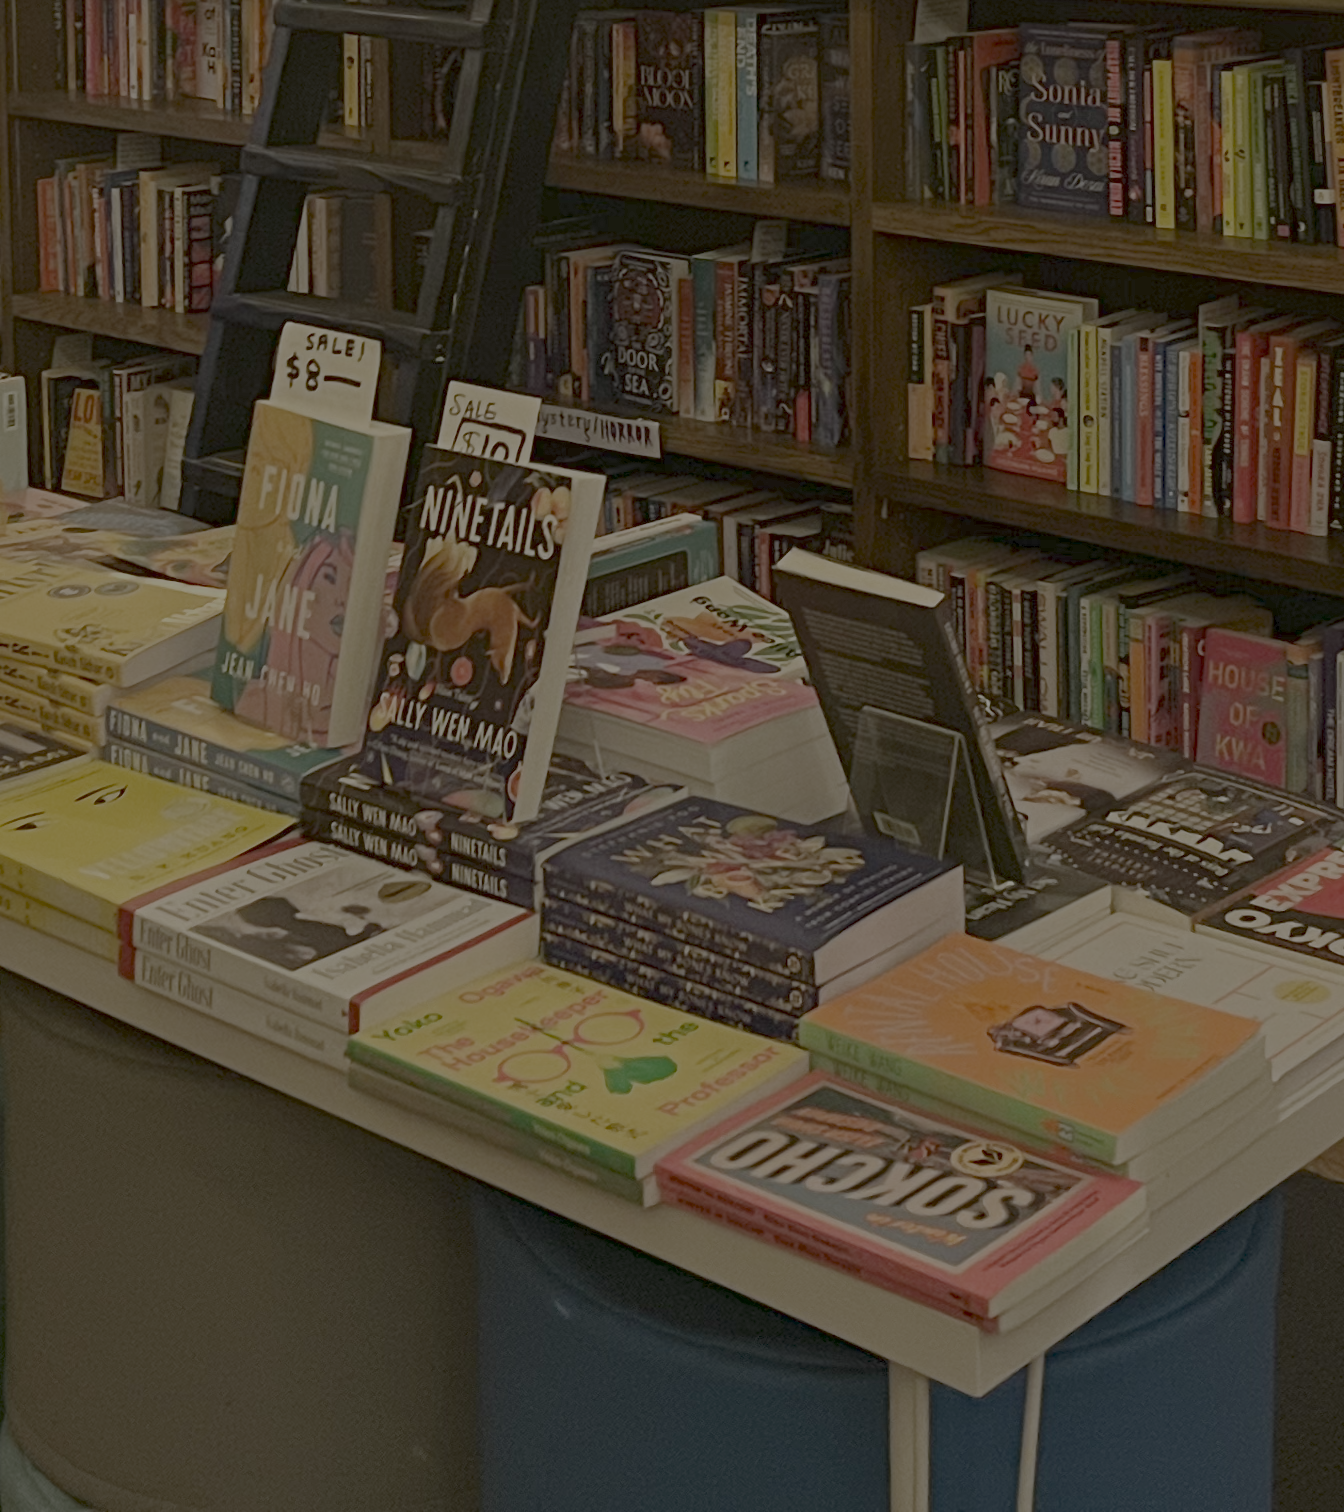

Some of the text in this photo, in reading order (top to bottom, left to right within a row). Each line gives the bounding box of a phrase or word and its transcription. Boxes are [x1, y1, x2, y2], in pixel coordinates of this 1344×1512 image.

[1030, 76, 1102, 108] Sonia
[1027, 112, 1105, 151] Sunny
[996, 306, 1068, 333] LUCKY
[1005, 327, 1056, 351] SEED
[306, 333, 367, 362] SALE!
[618, 348, 660, 373] DOOR
[449, 394, 497, 420] SALE
[624, 374, 650, 394] SEA
[1139, 354, 1151, 418] BLESSINGS
[461, 431, 510, 464] $10
[259, 464, 338, 533] FIONA
[421, 484, 558, 560] NINETAILS
[245, 573, 316, 641] JANE
[221, 651, 322, 706] JEAN CHEN HO
[1207, 660, 1286, 700] HOUSE
[377, 692, 519, 760] SALLY WEN MAO
[1229, 703, 1258, 728] OF
[110, 710, 147, 744] FIONA
[174, 735, 208, 766] JANE
[214, 750, 236, 772] JEAN
[237, 758, 261, 779] CHEN
[262, 767, 275, 784] HO
[110, 743, 209, 792] FIONA JANE
[1214, 739, 1266, 771] KWA
[1324, 707, 1336, 801] THE DREAM HOTEL
[329, 792, 507, 868] SALLY WEN MAO NINETAILS
[157, 840, 358, 925] Enter Ghost
[330, 822, 508, 898] SALLY WEN MAO NINETAILS
[139, 919, 212, 971] Enter Ghost
[931, 941, 1057, 994] HOUSE
[140, 955, 214, 1009] Enter Ghost
[458, 966, 547, 1006] Ogawa
[372, 1012, 444, 1043] Yoko
[417, 1035, 475, 1061] The
[653, 1021, 699, 1047] the
[657, 1044, 782, 1117] Professor
[709, 1129, 1037, 1230] SOKCHO
